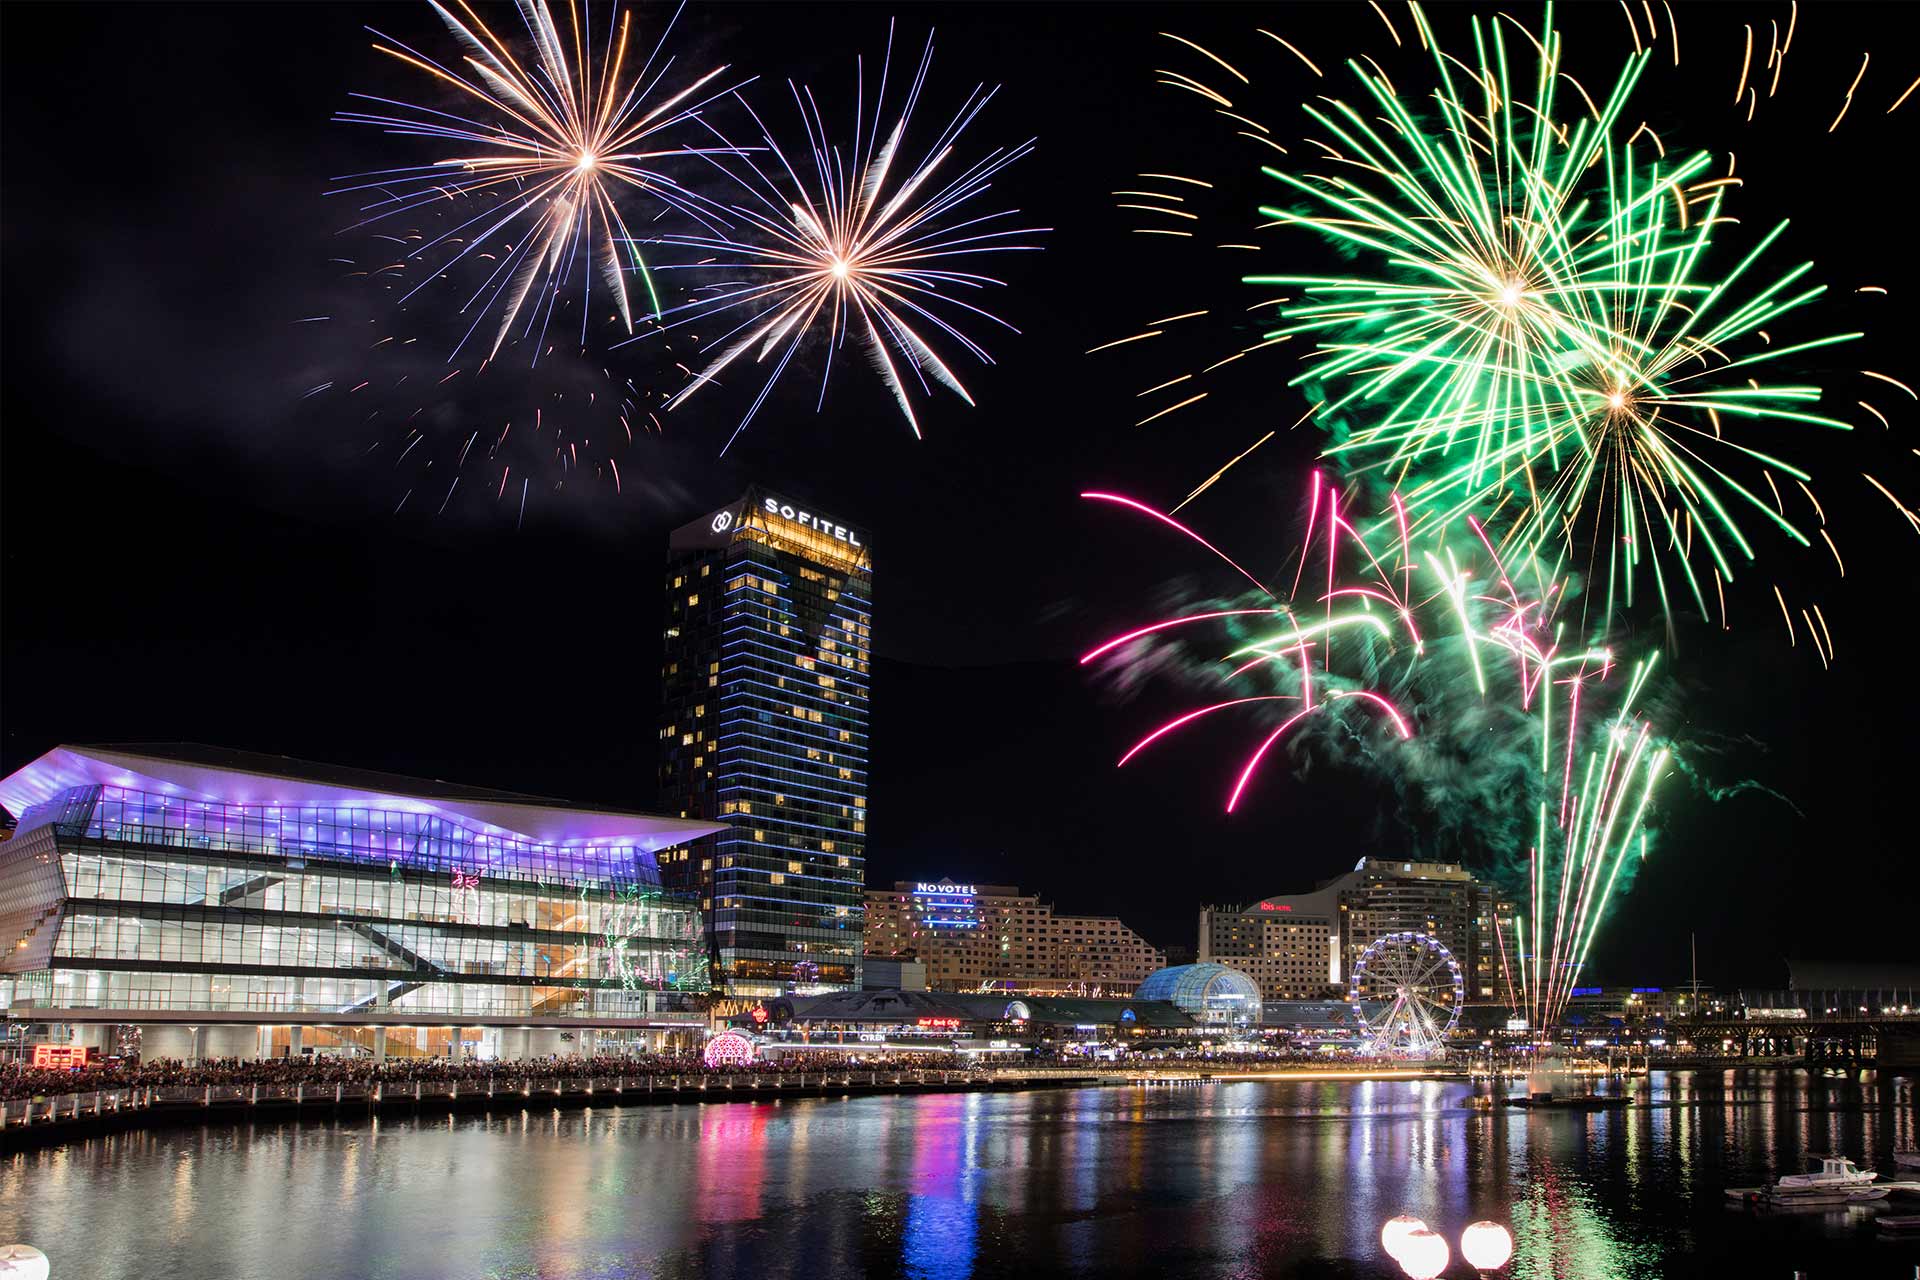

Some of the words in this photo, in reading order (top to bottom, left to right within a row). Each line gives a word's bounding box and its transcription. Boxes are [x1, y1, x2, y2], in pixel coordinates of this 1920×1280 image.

[765, 498, 861, 547] SOFITEL
[917, 882, 978, 895] NOVOTEL
[1261, 901, 1275, 911] ibis
[918, 1018, 931, 1026] Hard
[860, 1034, 886, 1042] CYREN
